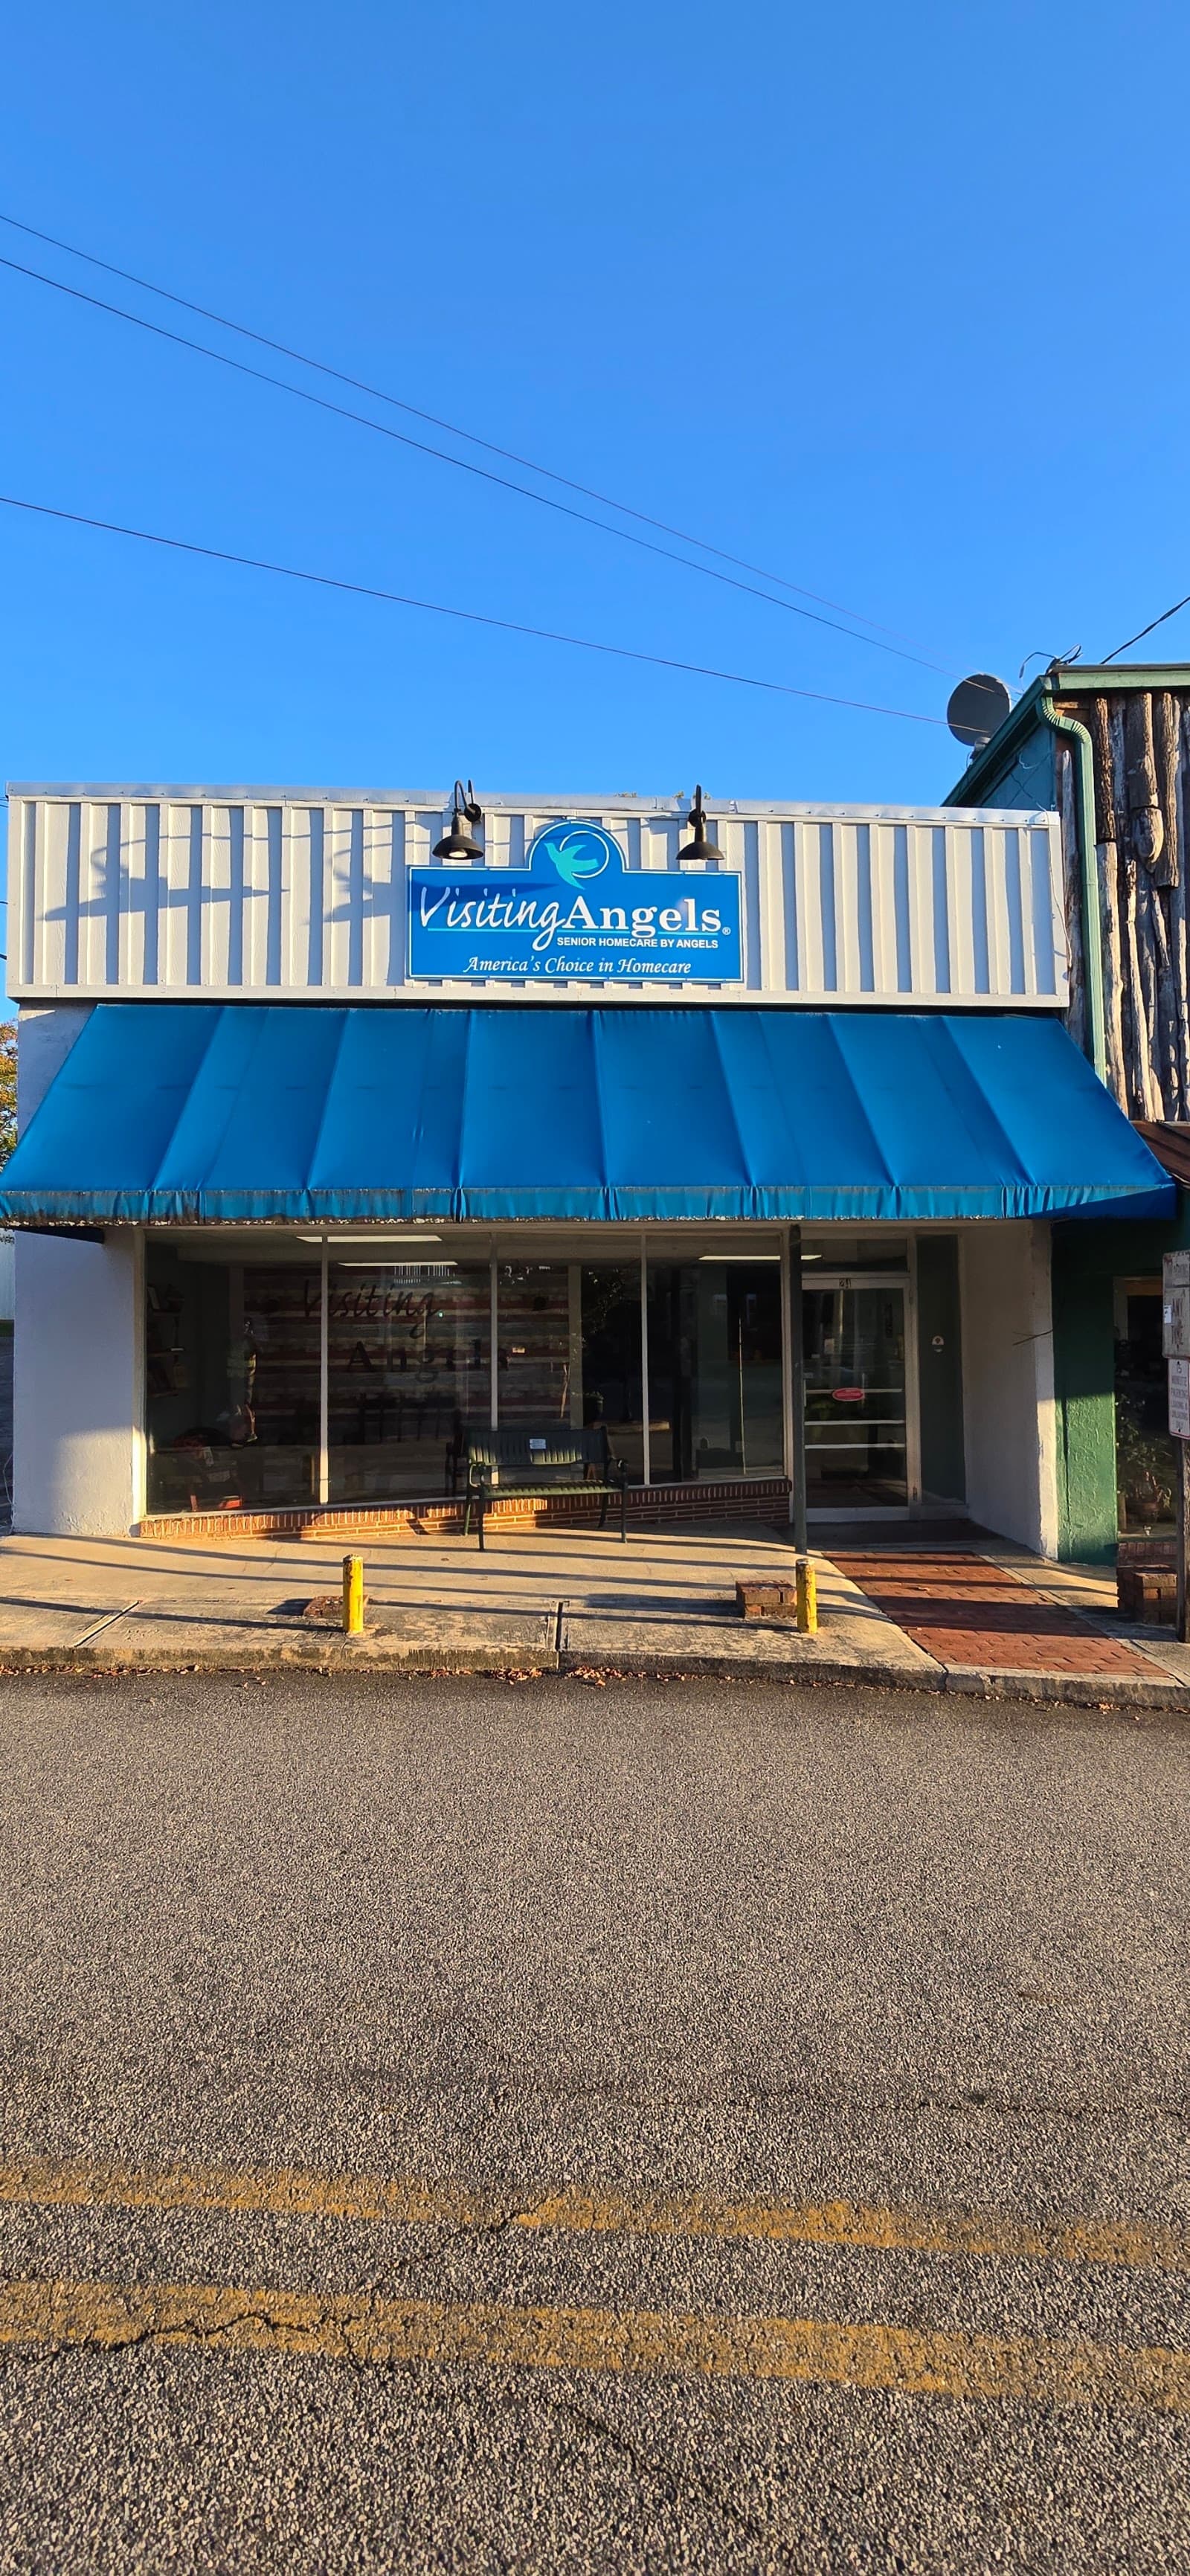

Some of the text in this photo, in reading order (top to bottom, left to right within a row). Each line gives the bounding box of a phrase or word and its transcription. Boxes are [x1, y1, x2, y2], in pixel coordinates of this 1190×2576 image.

[419, 886, 565, 951] Visiting
[557, 937, 718, 948] SENIOR HOMECARE BY ANGELS
[463, 956, 692, 974] America's Choice in Homecare
